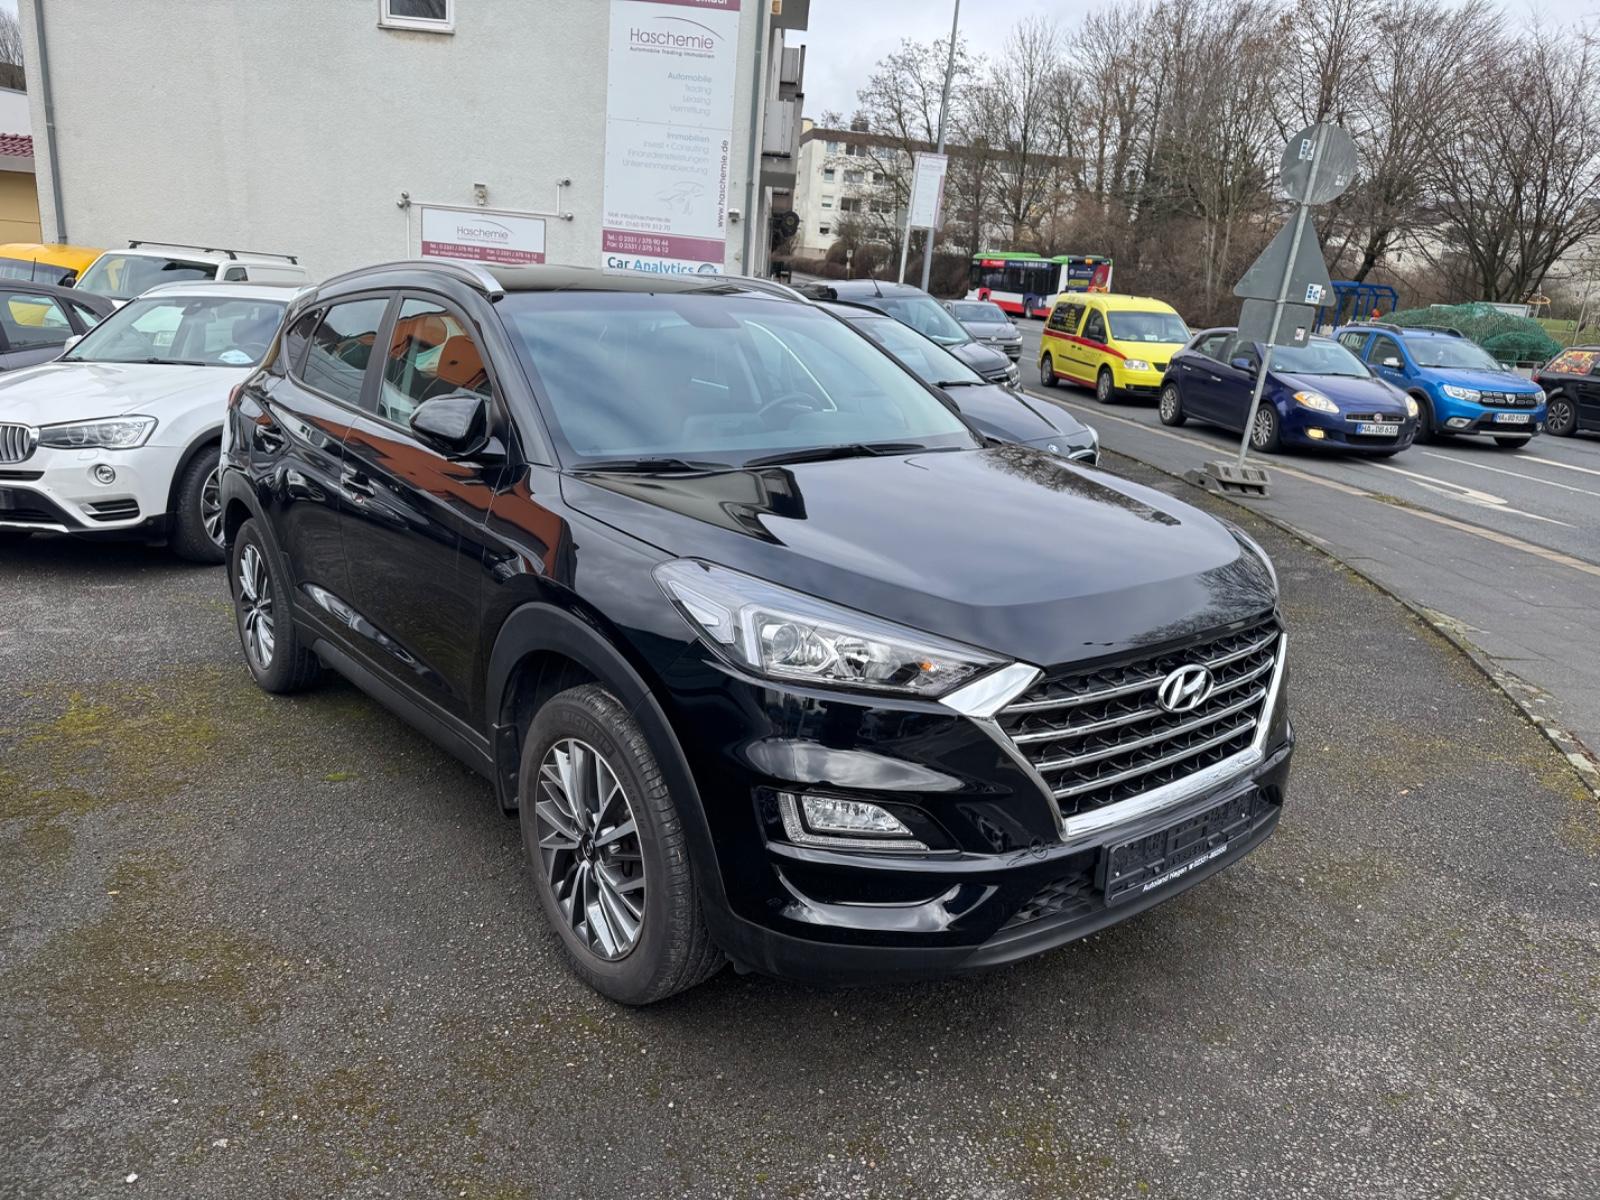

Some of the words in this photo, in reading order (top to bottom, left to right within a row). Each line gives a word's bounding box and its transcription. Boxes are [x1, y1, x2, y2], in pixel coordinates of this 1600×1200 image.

[630, 27, 714, 49] Haschemie
[667, 71, 712, 83] Automobile
[717, 140, 729, 228] www.haschemie.de
[456, 225, 508, 240] Haschemie
[607, 256, 630, 270] Car
[633, 259, 694, 274] Analytics
